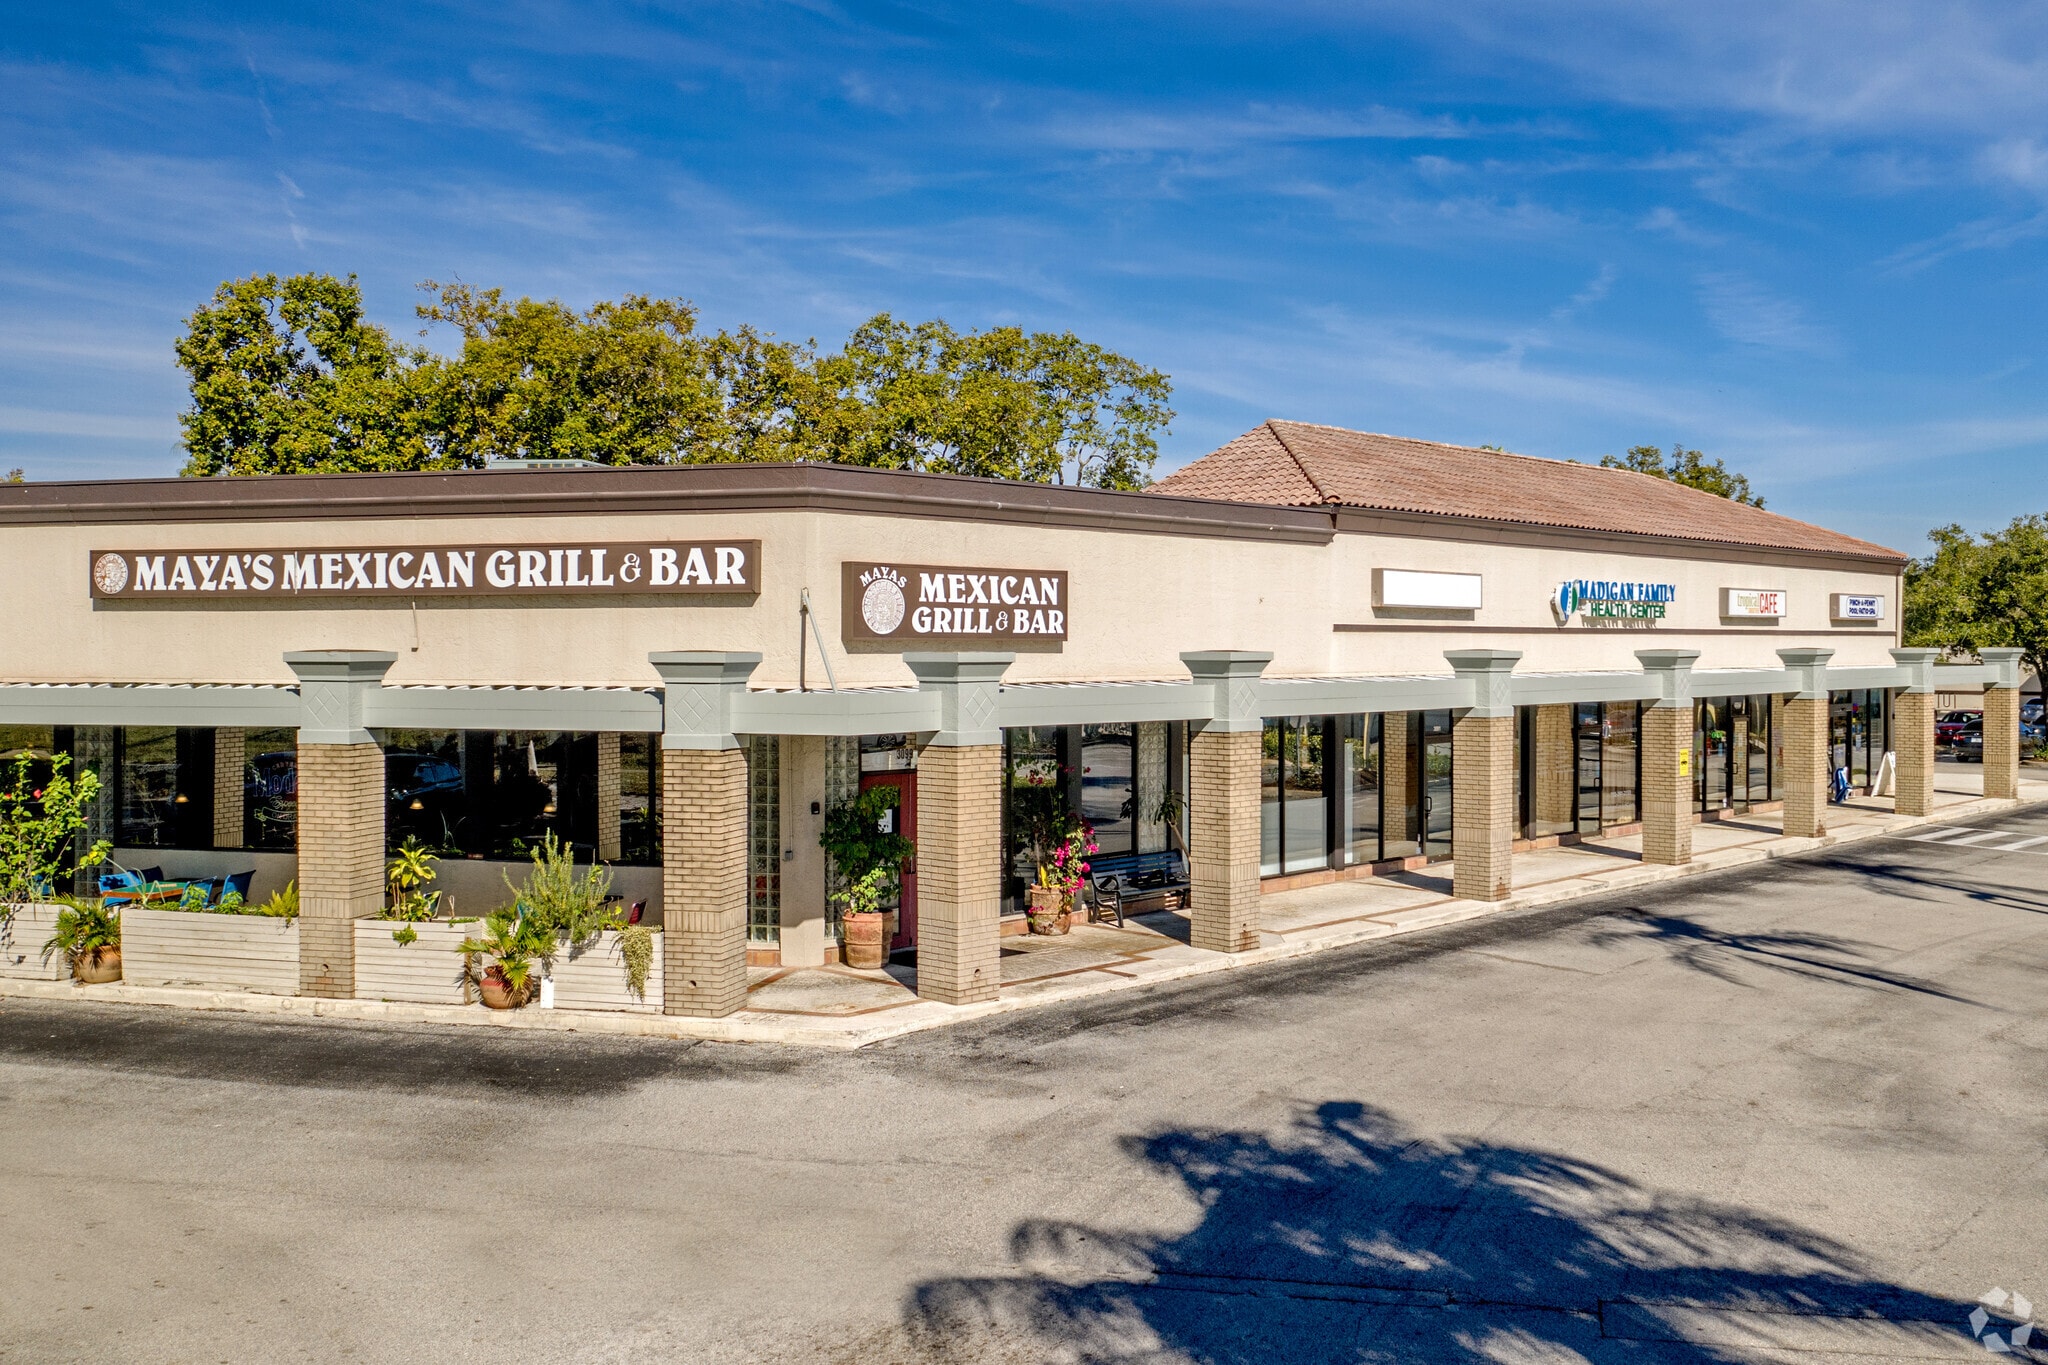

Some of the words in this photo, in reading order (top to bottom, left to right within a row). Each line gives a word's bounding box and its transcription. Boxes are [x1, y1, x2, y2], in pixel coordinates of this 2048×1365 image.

[133, 554, 275, 591] MAYA'S
[281, 552, 476, 590] MEXICAN
[484, 549, 614, 588] GRILL
[619, 553, 642, 583] &
[649, 547, 746, 586] BAR
[918, 572, 1059, 606] MEXICAN
[1578, 580, 1635, 601] MADIGAN
[1638, 583, 1676, 602] FAMILY
[1591, 602, 1627, 618] HEALTH
[1630, 604, 1666, 619] CENTER
[1760, 593, 1778, 614] CAFE
[911, 606, 993, 634] GRILL
[995, 611, 1009, 631] &
[1012, 608, 1064, 634] BAR
[896, 748, 913, 759] 3099
